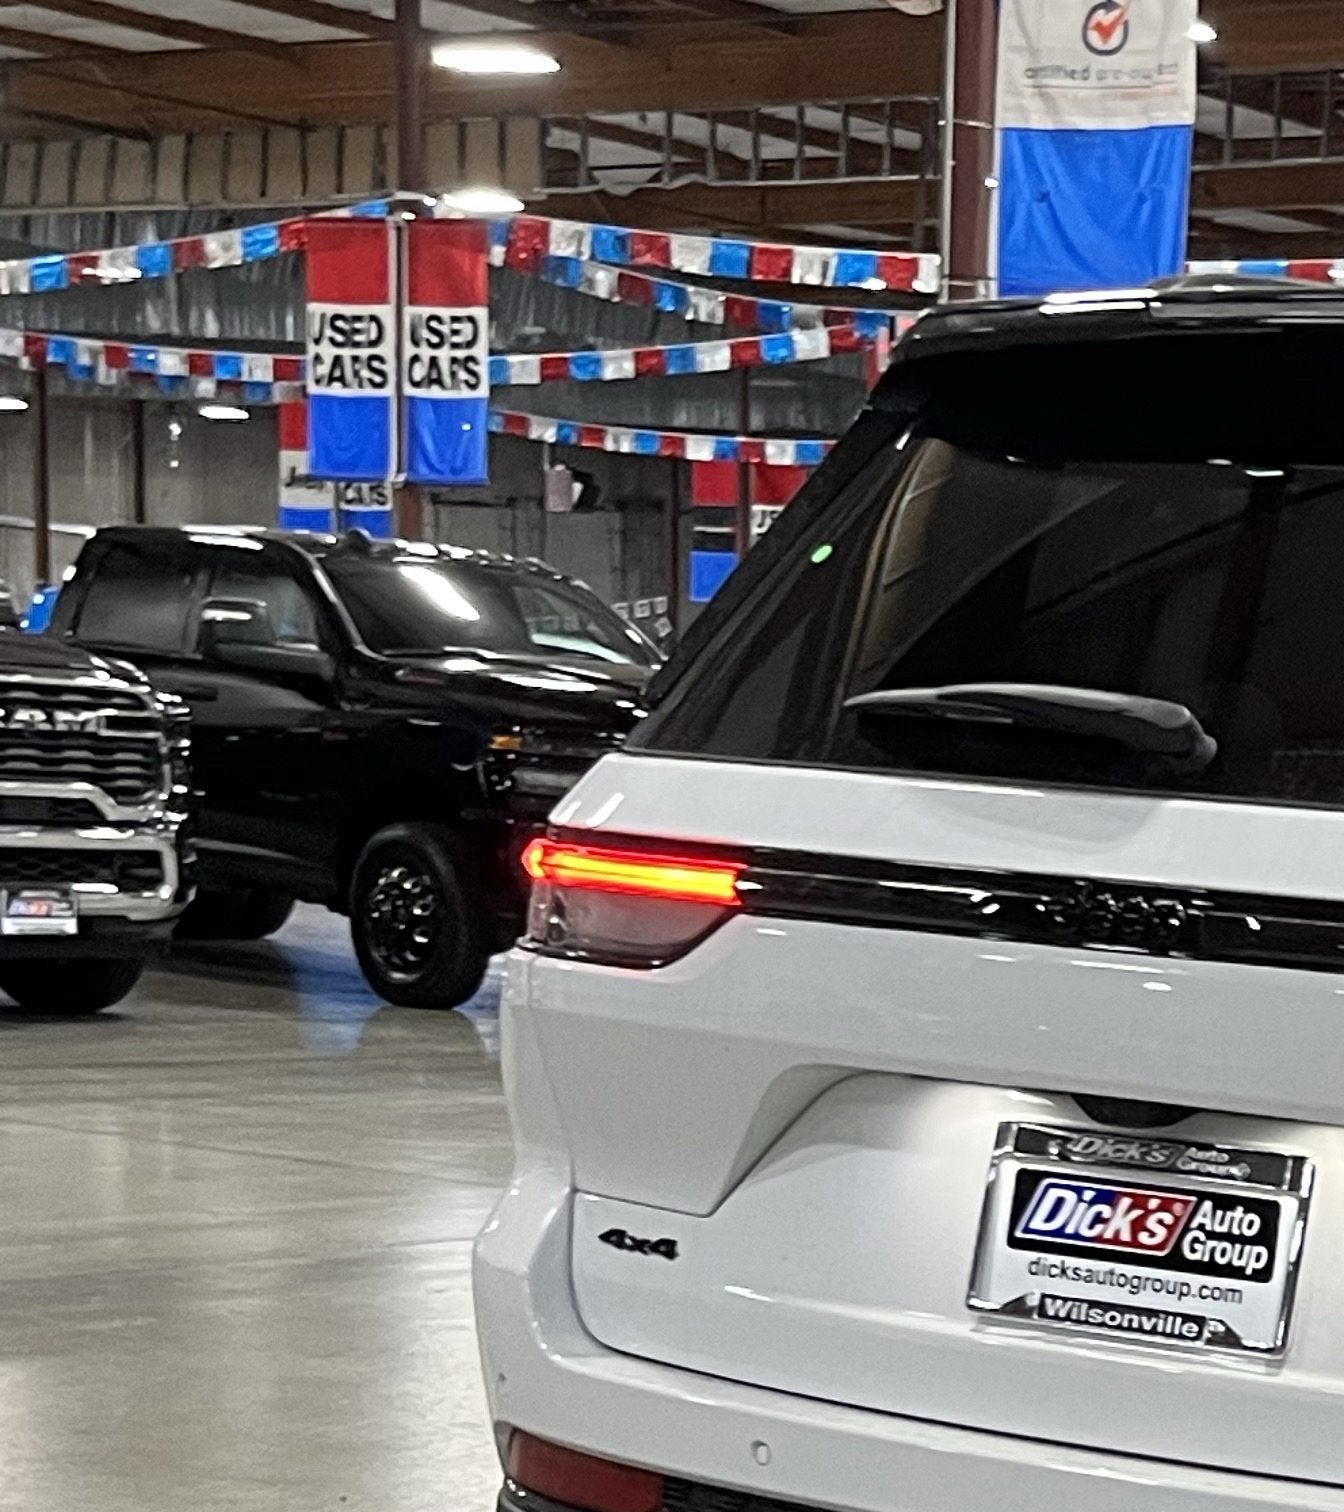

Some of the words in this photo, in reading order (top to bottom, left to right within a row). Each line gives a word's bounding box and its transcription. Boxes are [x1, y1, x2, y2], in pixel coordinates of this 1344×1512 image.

[309, 313, 385, 349] USED
[409, 313, 479, 351] USED
[312, 351, 389, 390] CARS
[407, 353, 482, 391] CARS
[1067, 1135, 1176, 1164] Dick's
[1027, 1186, 1177, 1247] Dick's
[1190, 1199, 1262, 1238] Auto
[597, 1227, 681, 1262] 4x4
[1181, 1230, 1270, 1276] Group
[1027, 1256, 1244, 1305] dicksautogroup.com
[1043, 1296, 1201, 1339] Wilsonville
